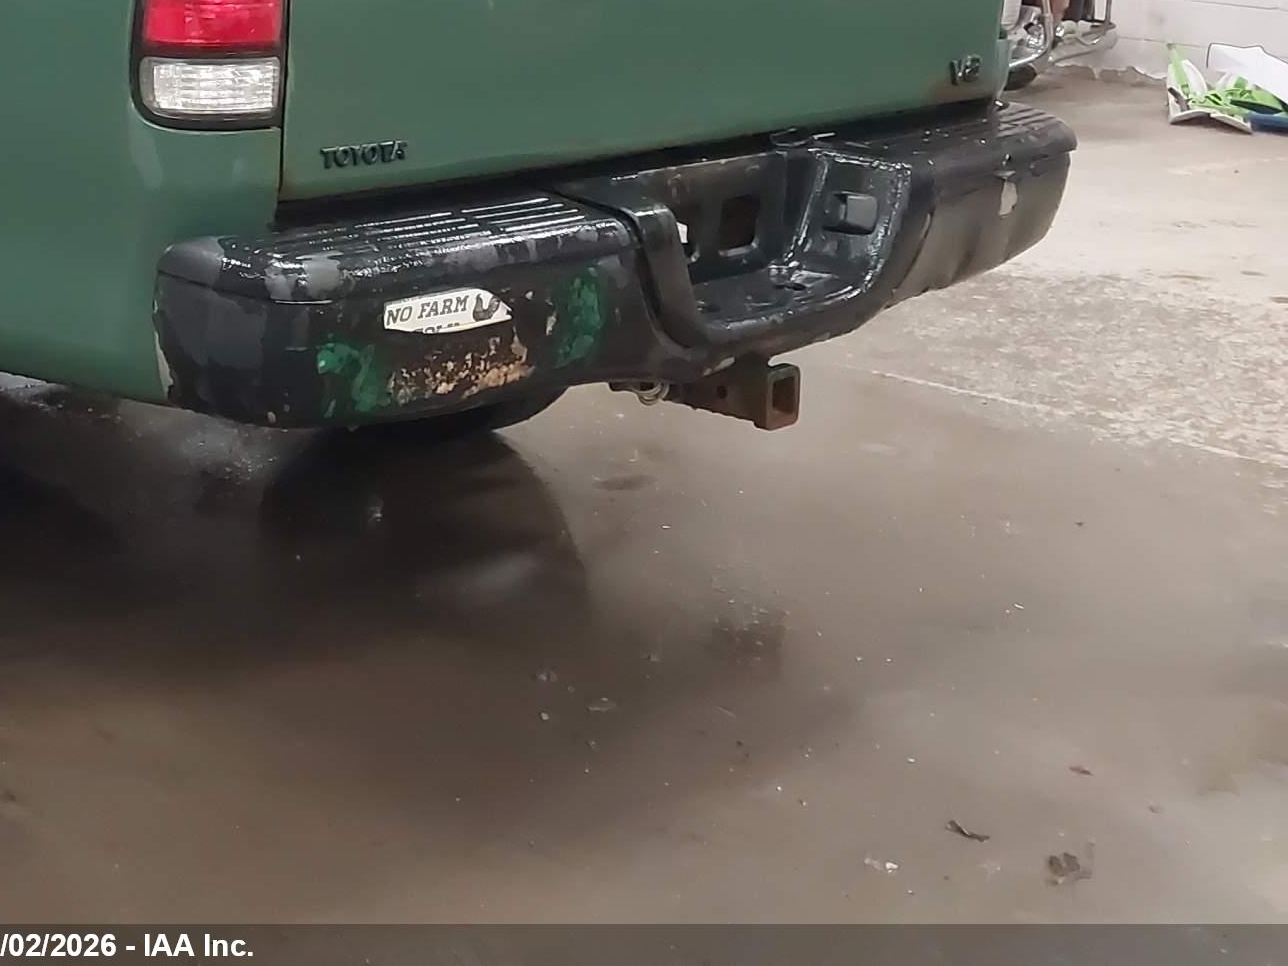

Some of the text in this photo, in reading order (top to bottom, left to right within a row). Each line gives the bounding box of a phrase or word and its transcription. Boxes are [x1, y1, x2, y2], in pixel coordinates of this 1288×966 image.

[320, 139, 408, 169] TOYOTA
[385, 294, 470, 326] NO FARM
